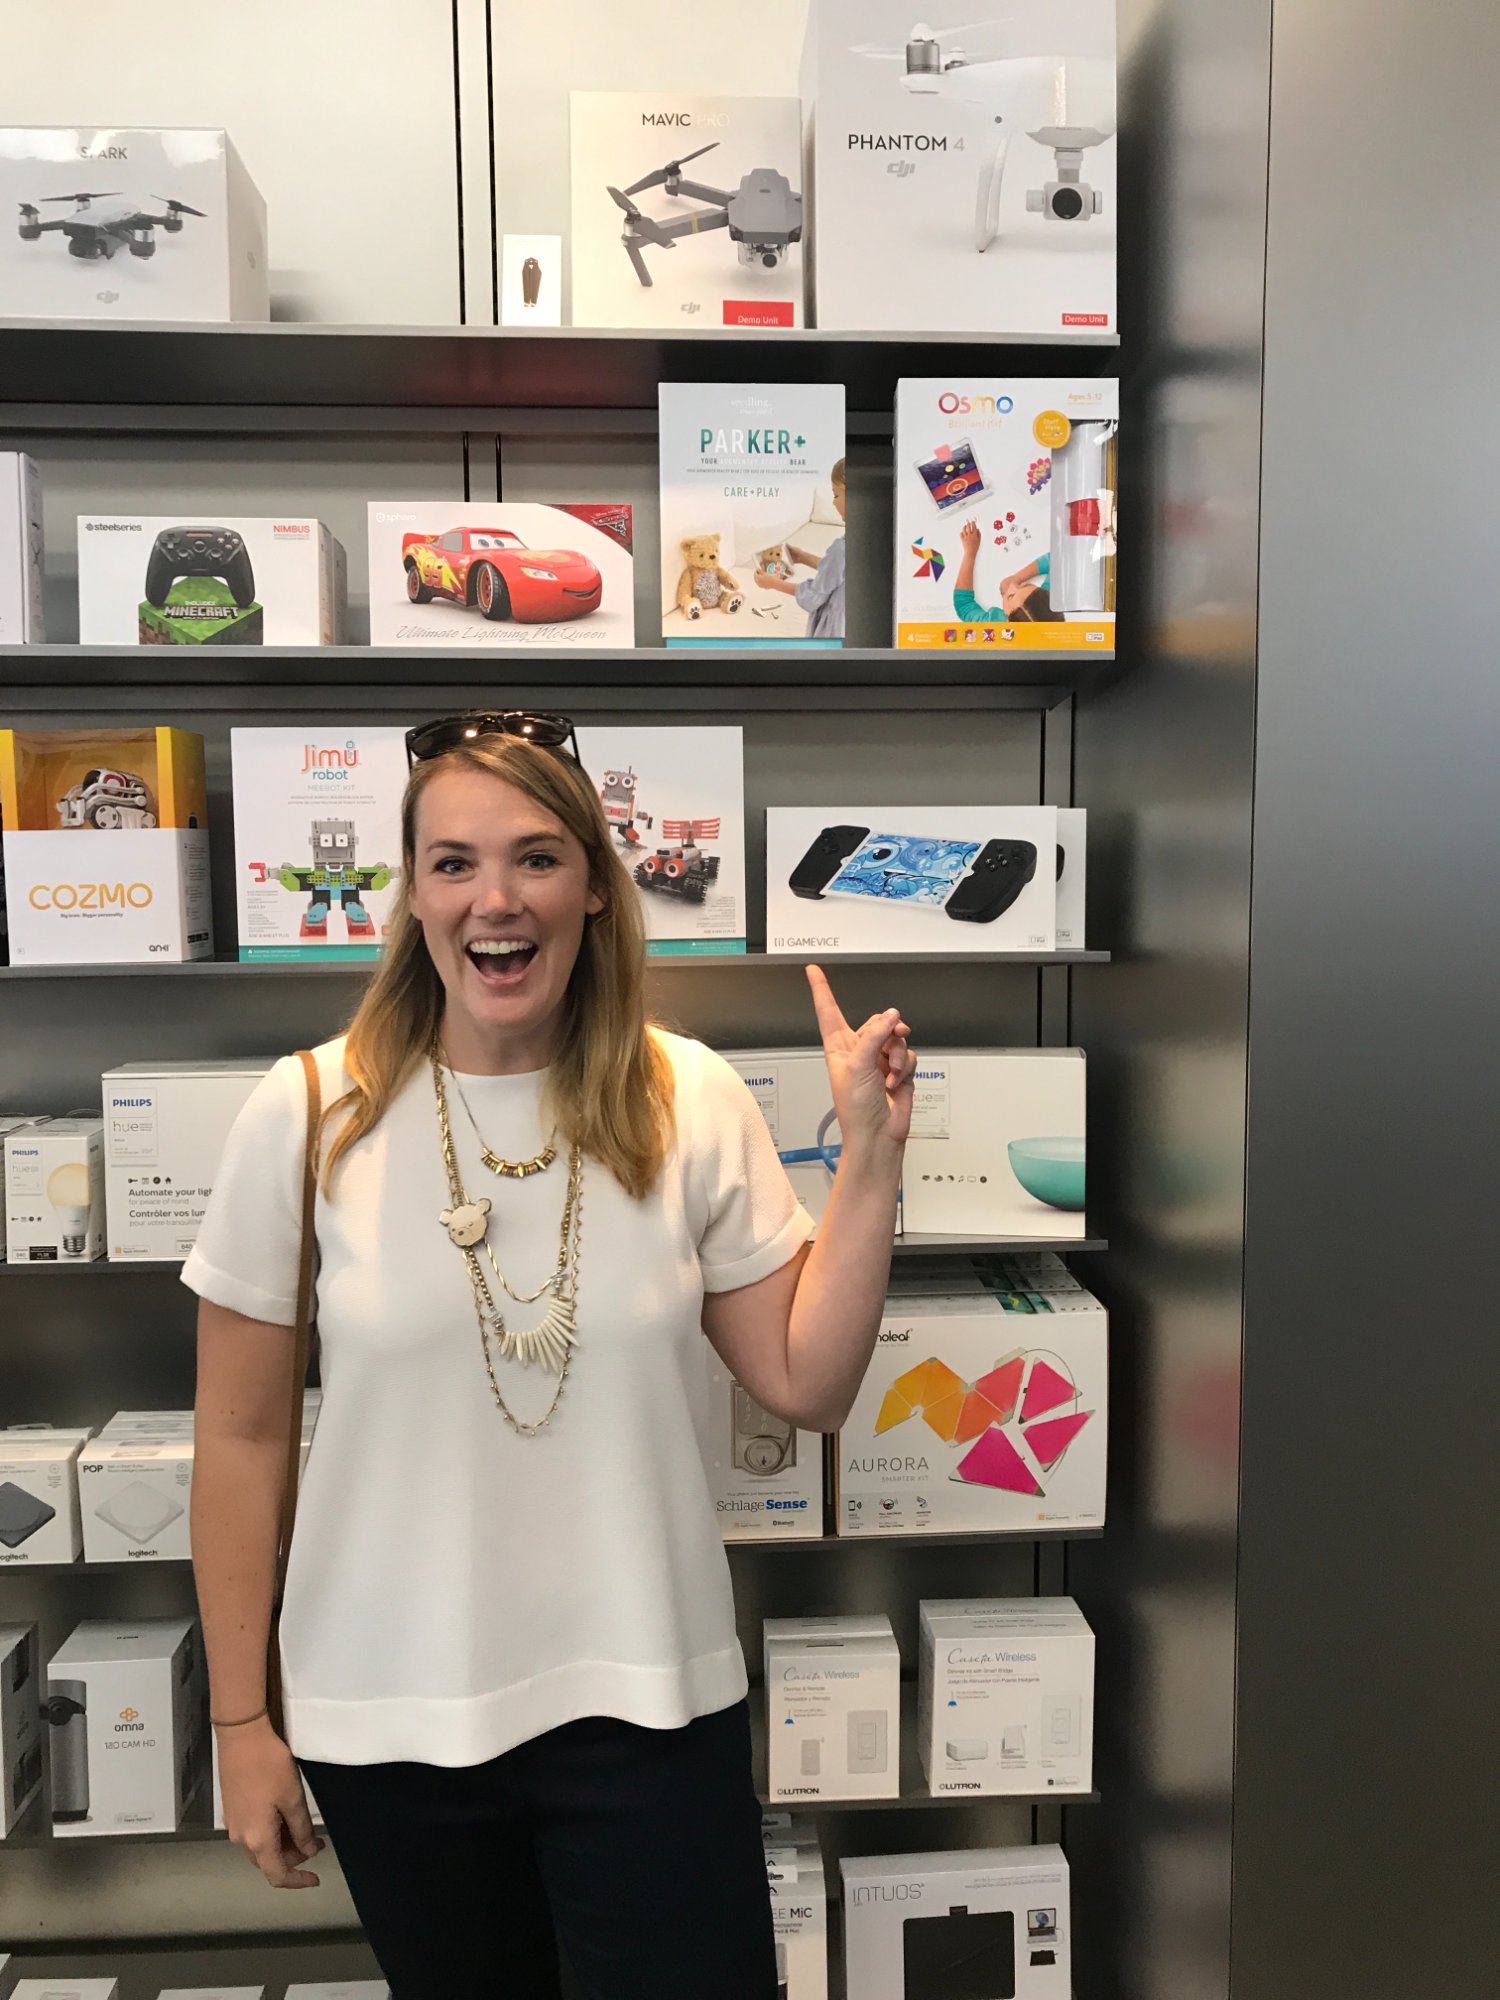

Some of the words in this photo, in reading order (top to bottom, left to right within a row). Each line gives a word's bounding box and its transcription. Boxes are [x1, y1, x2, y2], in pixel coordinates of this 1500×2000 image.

[642, 113, 691, 126] MAVIC
[697, 113, 730, 127] PRO
[848, 134, 947, 151] PHANTOM
[953, 137, 965, 151] 4
[80, 146, 128, 159] SARK
[738, 315, 760, 324] Demo
[763, 316, 778, 325] Unit
[1065, 315, 1087, 324] Demo
[1089, 315, 1104, 324] Unit
[938, 392, 1013, 414] Osmo
[724, 487, 748, 497] CARE
[757, 487, 780, 498] PLAY
[94, 523, 142, 531] steelseries
[273, 525, 310, 534] NIMBUS
[164, 605, 239, 619] MINECRAFT
[396, 626, 460, 639] Ultimate
[461, 626, 529, 642] Lightning
[530, 626, 607, 641] McQueen
[313, 769, 348, 780] robot
[29, 883, 153, 910] COZMO
[786, 937, 840, 947] GAMEVICE
[914, 1071, 946, 1080] HILIPS
[744, 1077, 774, 1086] HILIPS
[113, 1098, 152, 1107] PHILIPS
[113, 1121, 139, 1132] hue
[128, 1189, 173, 1197] Automate
[175, 1189, 195, 1197] your
[129, 1210, 171, 1218] Contrôler
[877, 1329, 910, 1342] noleaf
[83, 1465, 103, 1473] POP
[848, 1457, 929, 1473] AURORA
[716, 1500, 765, 1512] Schlage
[766, 1499, 808, 1510] Sense
[0, 1553, 28, 1562] ogitech
[128, 1550, 158, 1559] logitech
[995, 1652, 1037, 1662] Wireless
[824, 1671, 860, 1679] Wireless
[115, 1723, 144, 1732] omna
[104, 1741, 119, 1749] 180
[790, 1907, 813, 1919] MiC
